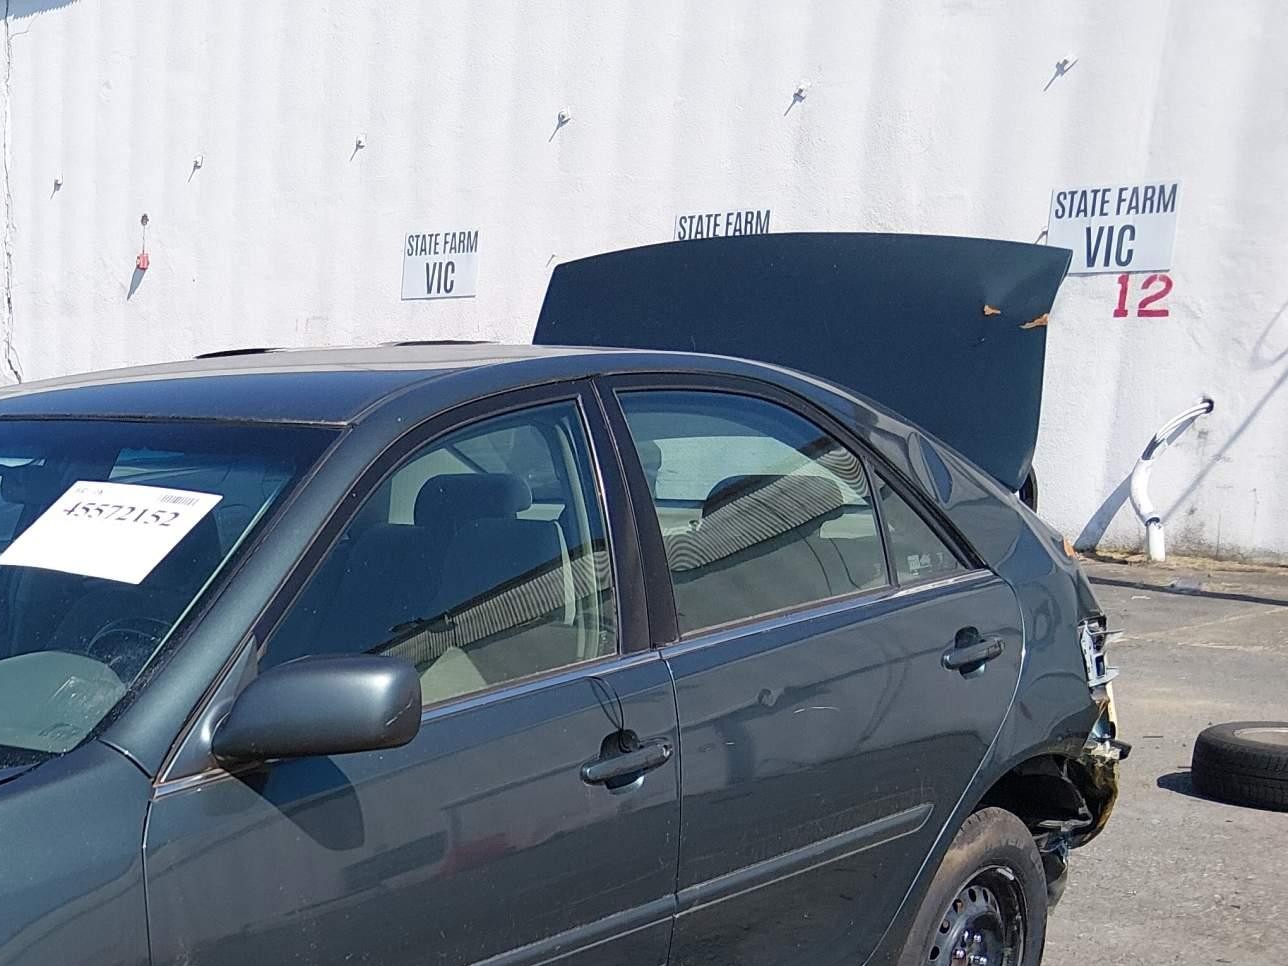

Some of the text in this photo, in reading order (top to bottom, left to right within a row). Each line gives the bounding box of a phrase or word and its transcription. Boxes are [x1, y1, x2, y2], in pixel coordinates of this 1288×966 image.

[1054, 183, 1178, 219] STATE FARM
[678, 209, 770, 240] STATE FARM
[407, 230, 479, 256] STATE FARM
[1085, 224, 1136, 268] VIC
[425, 260, 456, 295] VIC
[1113, 272, 1173, 318] 12
[62, 501, 181, 527] 45572152
